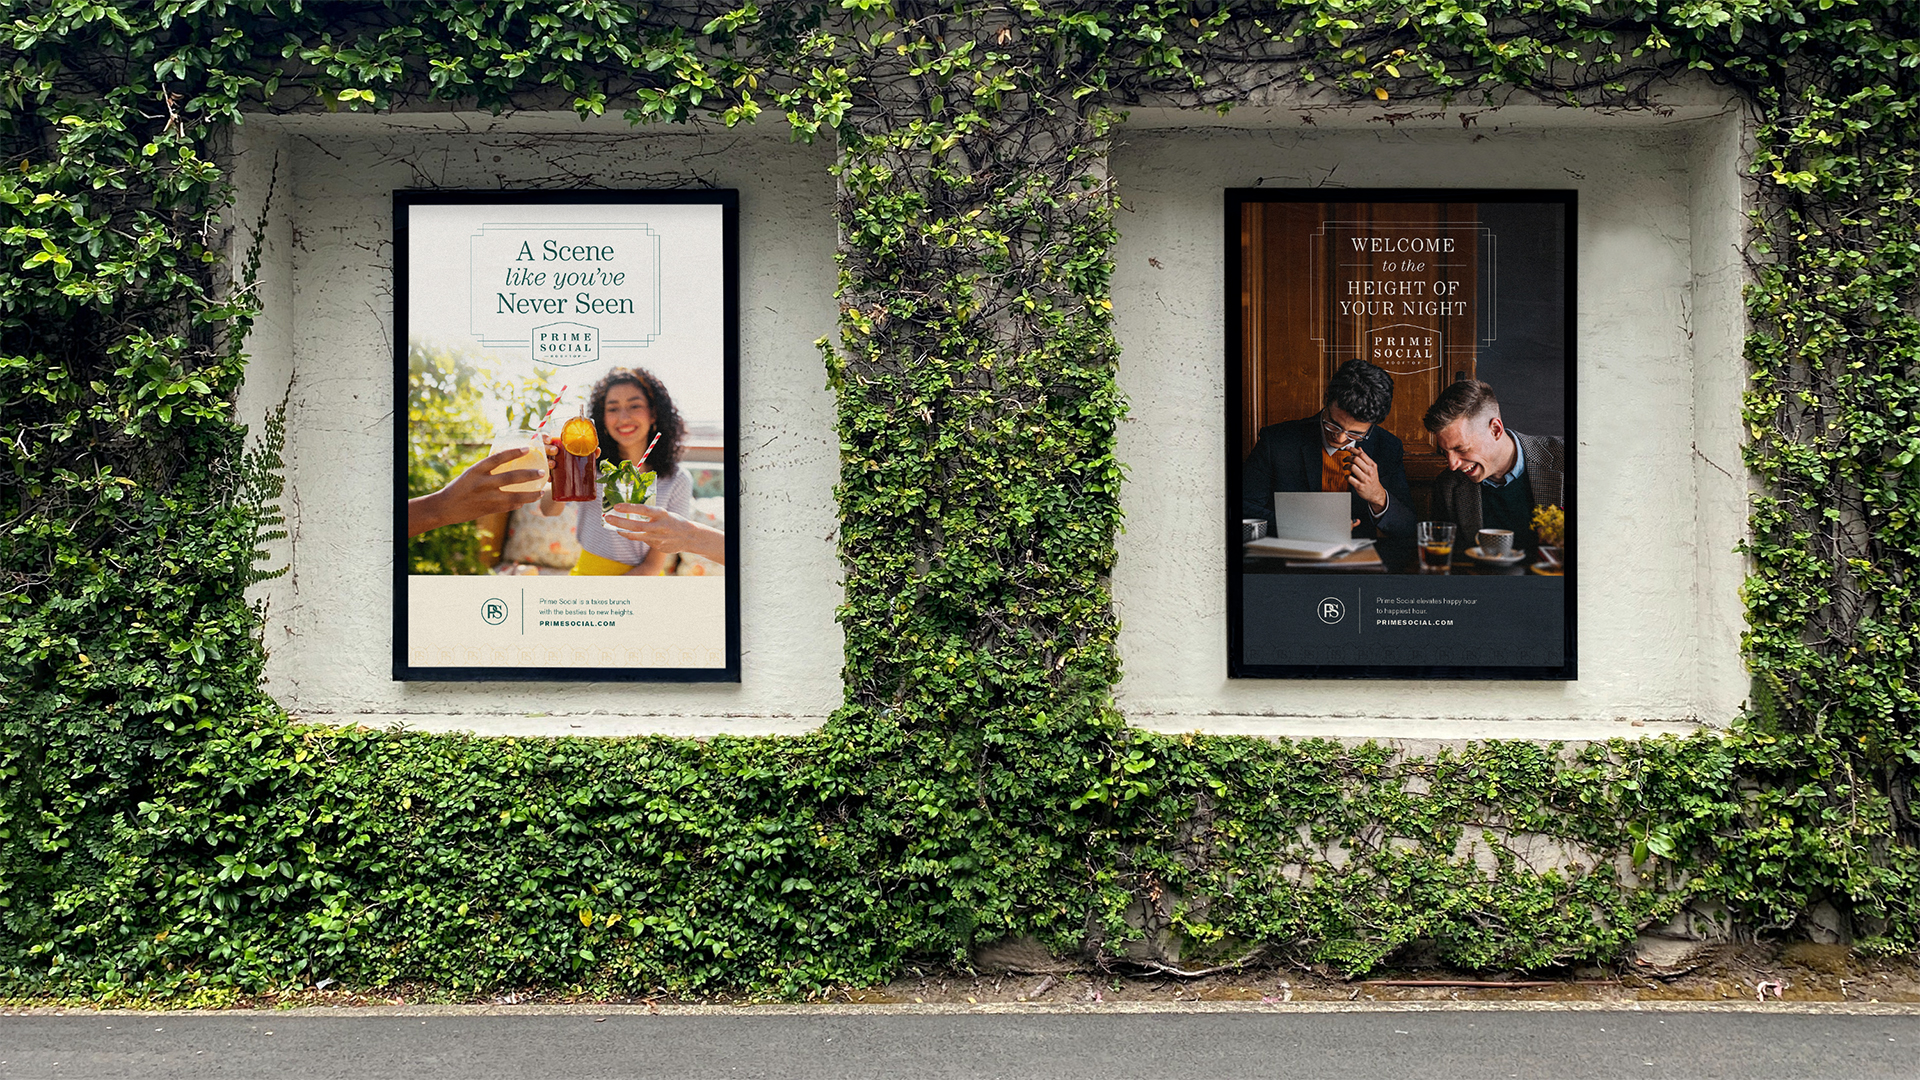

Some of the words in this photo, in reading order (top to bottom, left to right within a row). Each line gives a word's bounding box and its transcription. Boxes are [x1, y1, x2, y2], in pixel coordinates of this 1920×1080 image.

[515, 240, 535, 261] A
[543, 239, 615, 261] Scene
[1351, 238, 1455, 252] WELCOME
[1382, 260, 1397, 272] to
[1401, 259, 1426, 272] the
[505, 267, 547, 286] like
[553, 267, 626, 290] you’ve
[1347, 281, 1426, 295] HEIGHT
[1433, 281, 1460, 295] OF
[496, 292, 568, 314] Never
[575, 292, 635, 314] Seen
[1340, 301, 1395, 316] YOUR
[1402, 301, 1467, 316] NIGHT
[540, 333, 592, 341] PRIME
[1374, 337, 1433, 346] PRIME
[540, 343, 592, 352] SOCIAL
[1374, 348, 1433, 358] SOCIAL
[1443, 598, 1462, 606] happy
